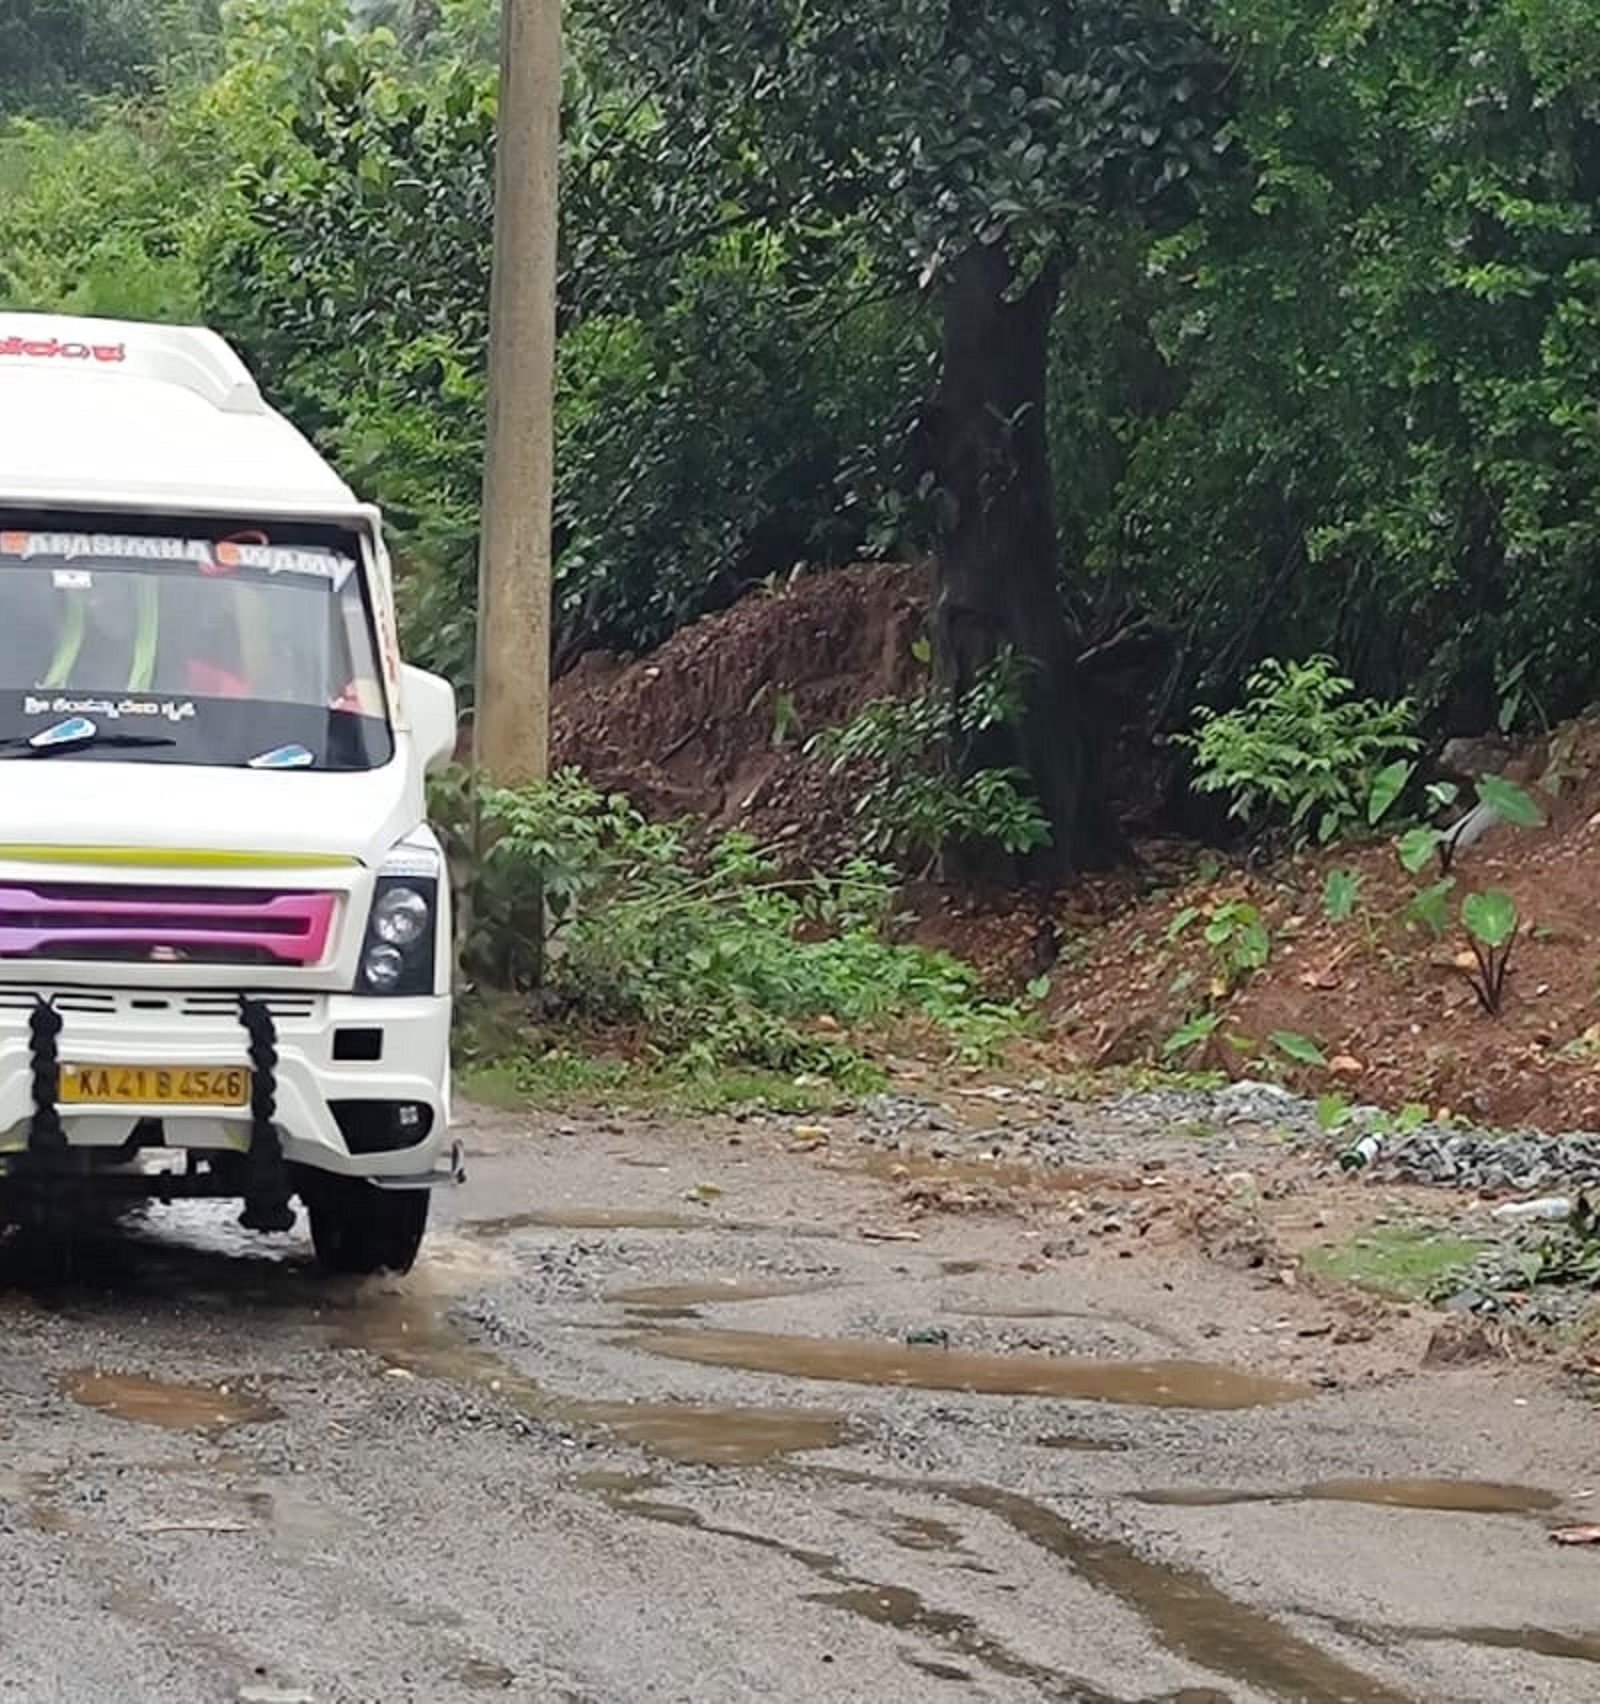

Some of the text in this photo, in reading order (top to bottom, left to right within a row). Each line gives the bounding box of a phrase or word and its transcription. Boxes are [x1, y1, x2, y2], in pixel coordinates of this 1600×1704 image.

[78, 1071, 241, 1098] KA 41 B 4546
